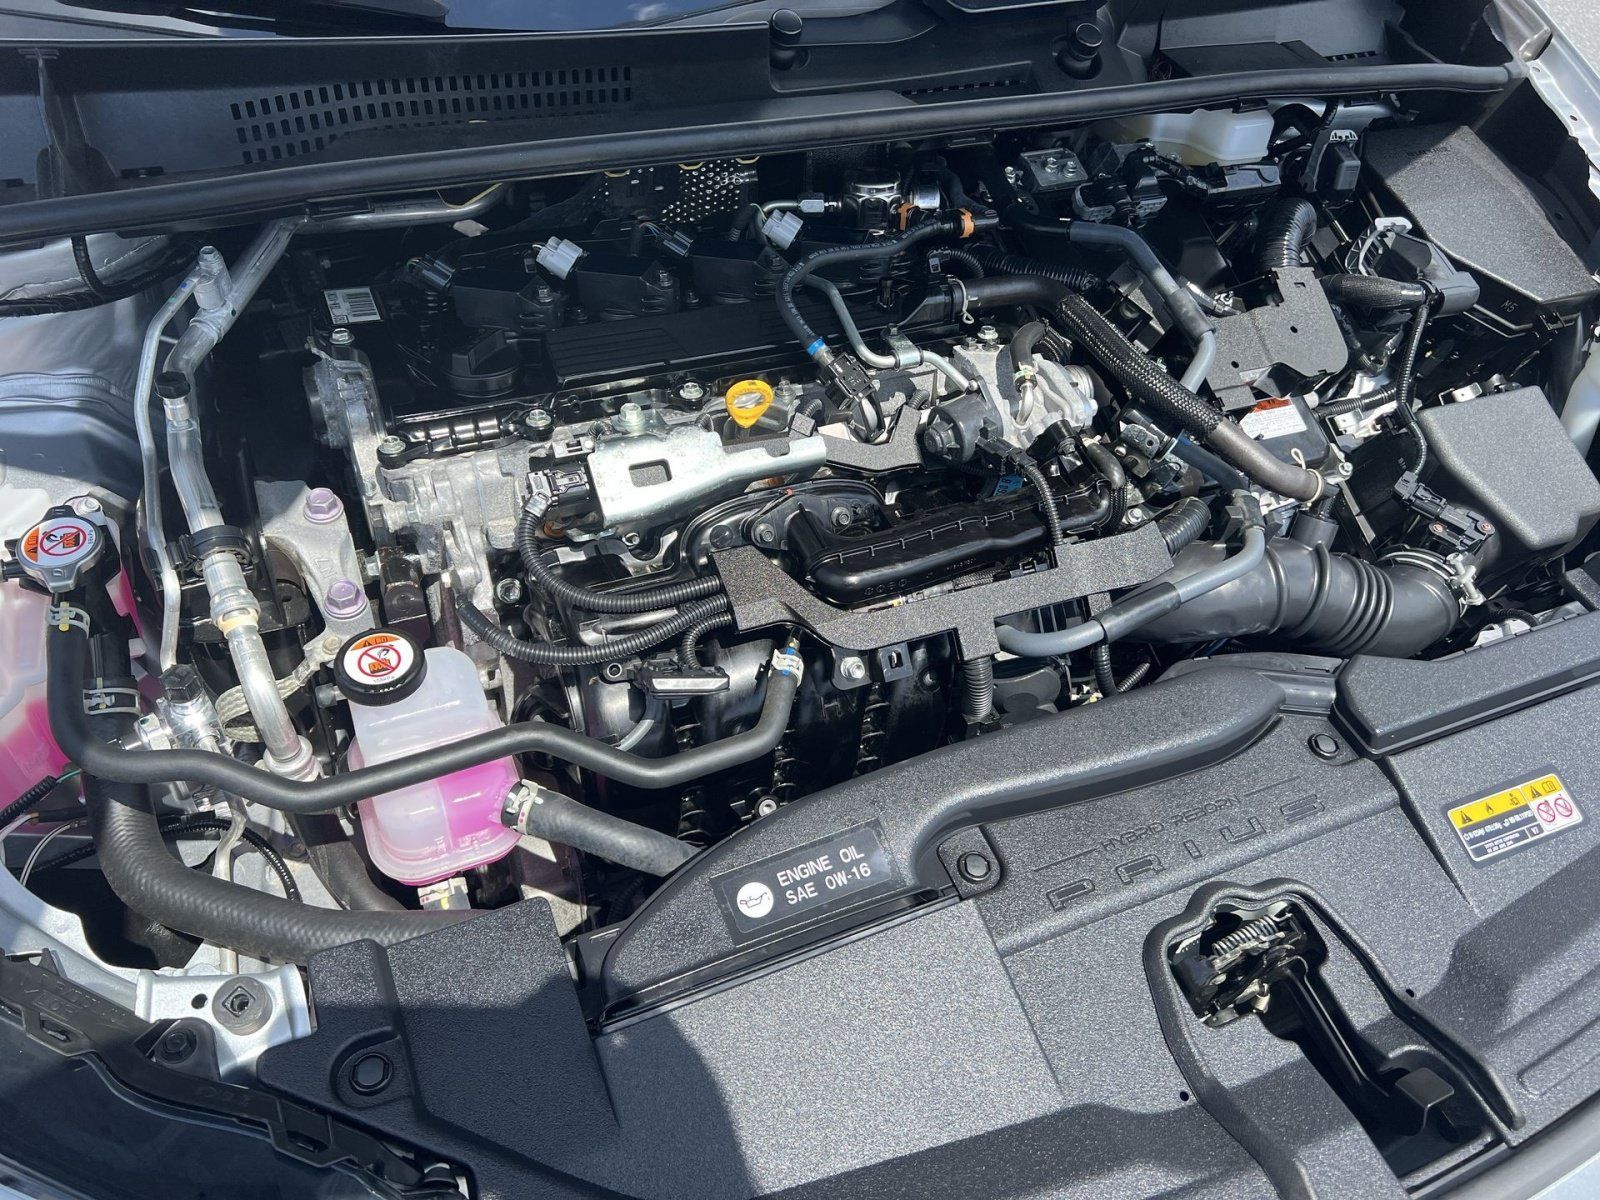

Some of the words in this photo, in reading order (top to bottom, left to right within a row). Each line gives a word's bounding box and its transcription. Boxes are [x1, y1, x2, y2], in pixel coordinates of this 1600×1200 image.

[1100, 821, 1165, 851] HYBRID
[1170, 794, 1241, 826] REBORN
[776, 854, 834, 887] ENGINE
[839, 845, 865, 863] OIL
[1045, 793, 1325, 911] PRIUS
[785, 882, 819, 905] SAE
[824, 862, 872, 890] 0W-16
